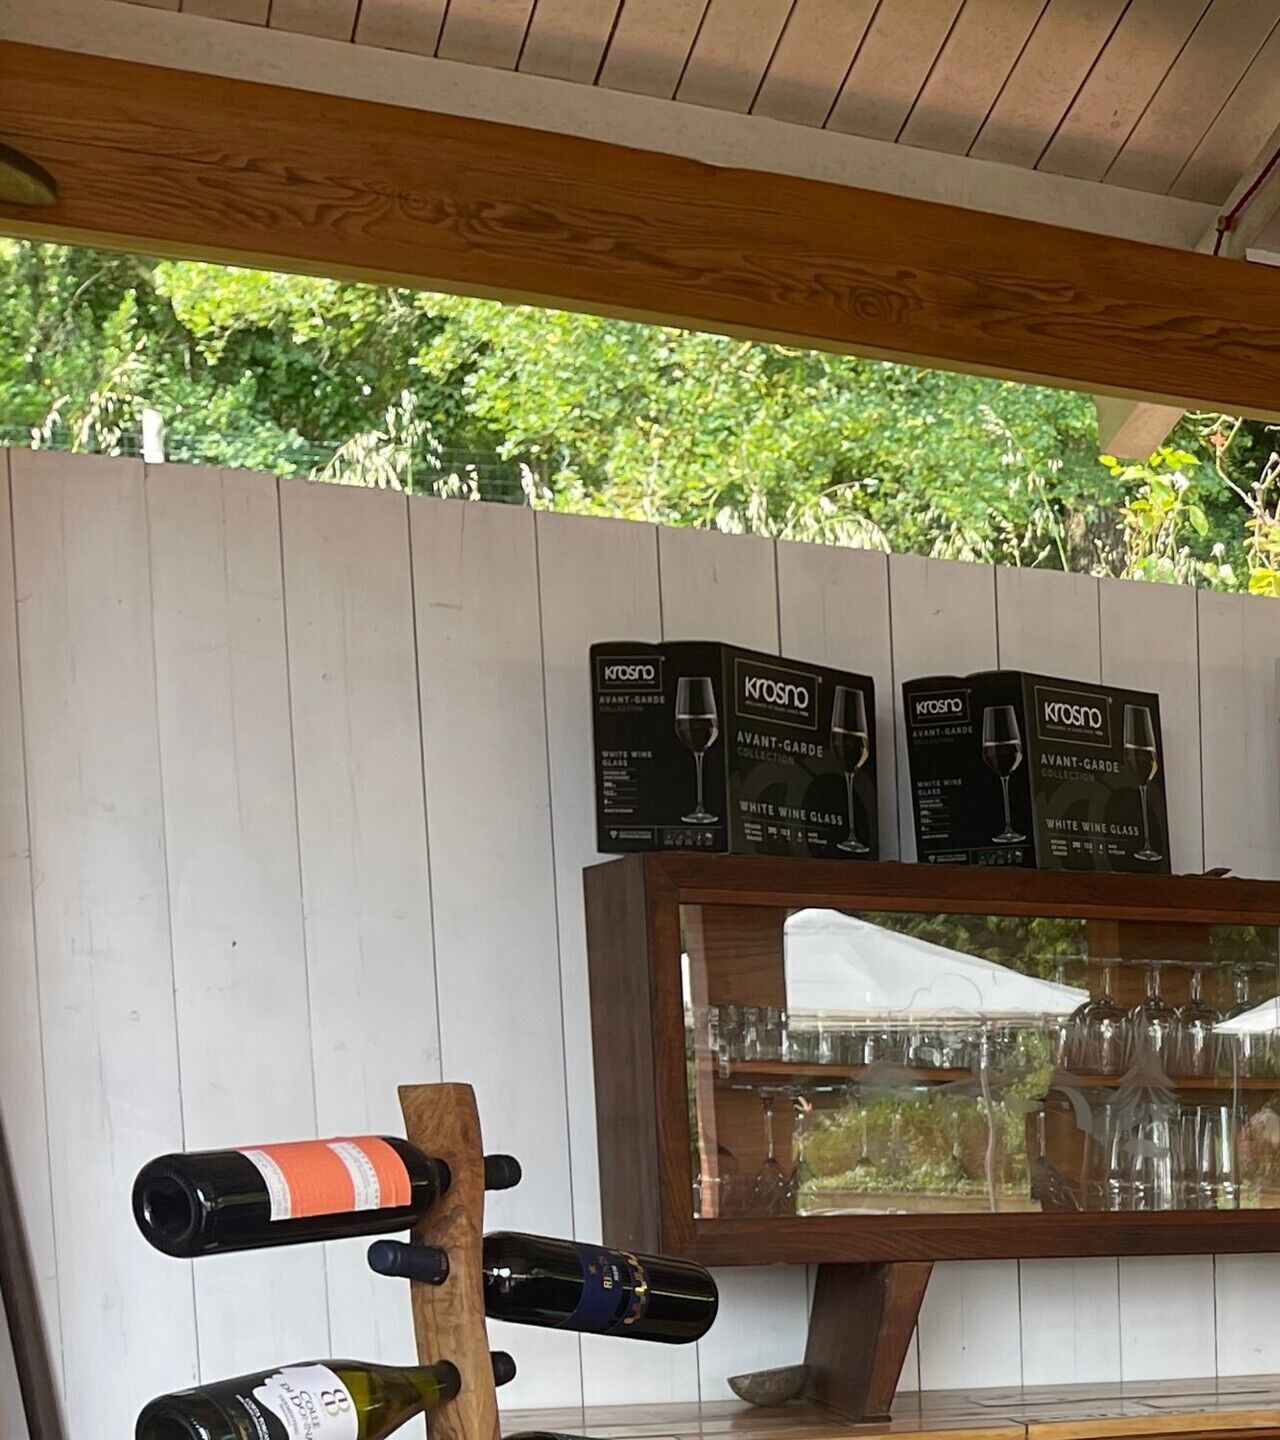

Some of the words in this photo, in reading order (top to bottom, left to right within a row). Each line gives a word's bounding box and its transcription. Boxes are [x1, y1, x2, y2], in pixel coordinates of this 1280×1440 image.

[737, 731, 824, 758] AVANT-GARDE
[1040, 753, 1120, 773] AVANT-GARDE
[739, 800, 775, 816] WHITE
[778, 806, 806, 820] WINE
[809, 811, 843, 826] GLASS
[1045, 819, 1078, 831] WHITE
[1081, 821, 1107, 833] WINE
[1110, 824, 1139, 836] GLASS
[300, 1390, 321, 1430] COLLE
